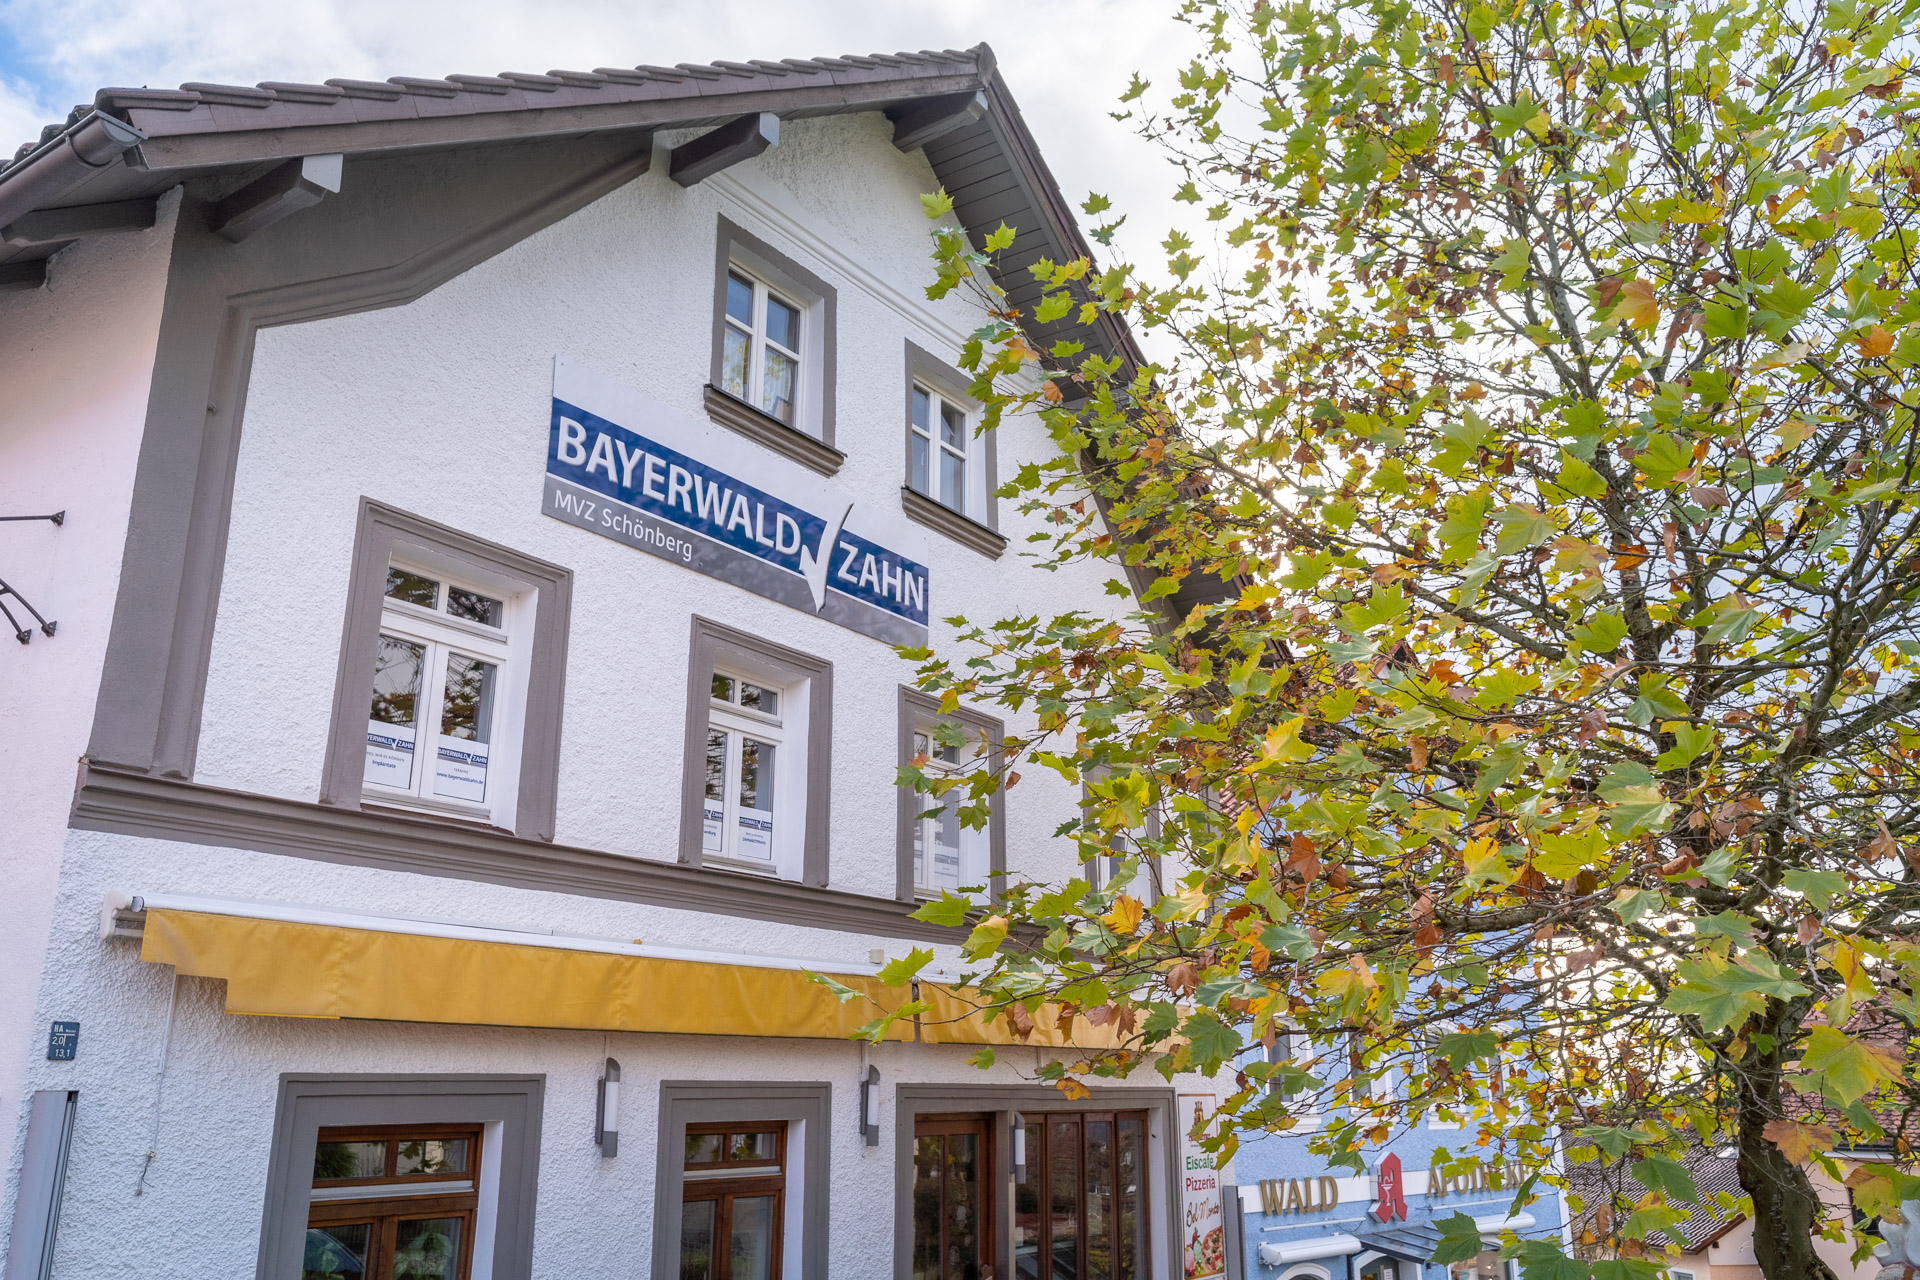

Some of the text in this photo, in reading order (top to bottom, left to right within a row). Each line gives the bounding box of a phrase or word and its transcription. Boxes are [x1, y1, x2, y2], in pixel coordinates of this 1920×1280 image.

[557, 416, 924, 611] BAYERWALD ZAHN
[555, 490, 693, 562] MVZ Schönberg
[397, 741, 414, 749] ZAHN
[438, 748, 487, 764] BAYERWALD ZAHN
[372, 760, 397, 769] Implantate
[54, 1024, 63, 1033] HA
[1185, 1175, 1216, 1192] Pizzeria
[1260, 1175, 1339, 1217] WALD
